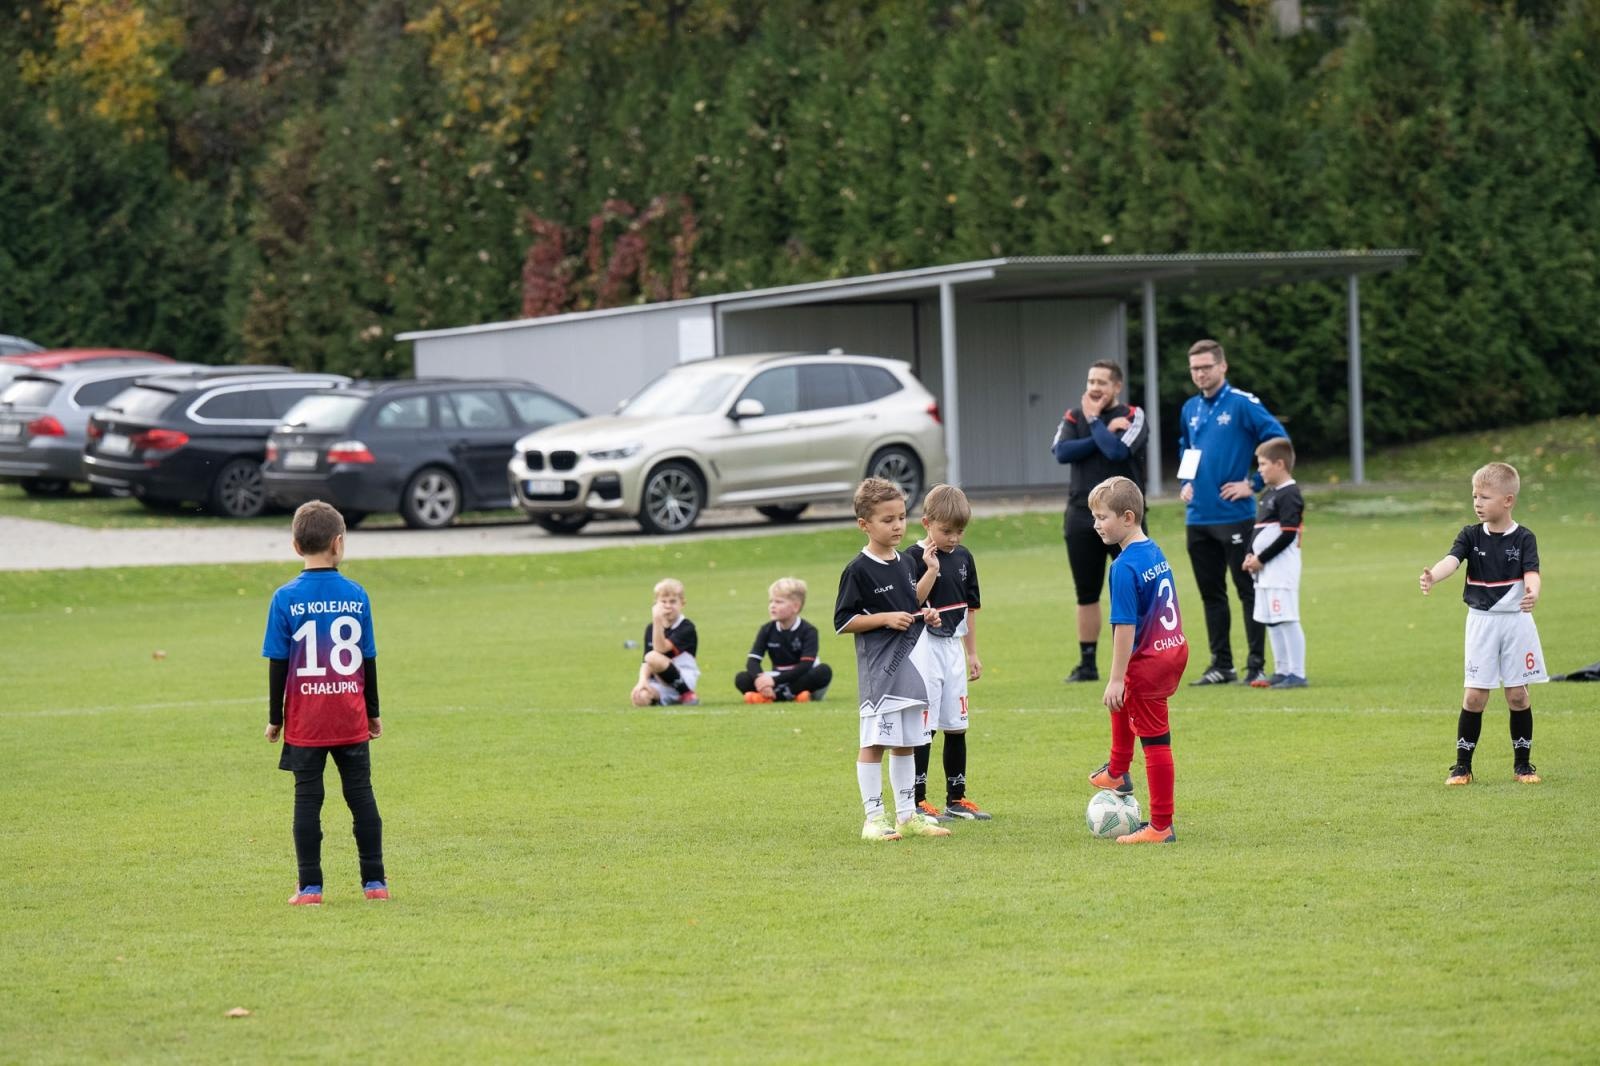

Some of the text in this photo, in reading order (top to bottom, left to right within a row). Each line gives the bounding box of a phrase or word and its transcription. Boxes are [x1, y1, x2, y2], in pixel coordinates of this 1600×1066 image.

[1142, 568, 1156, 583] KS
[290, 601, 363, 616] KS KOLEJARZ
[1158, 577, 1178, 631] 3
[1272, 600, 1281, 613] 6
[292, 615, 363, 677] 18
[1525, 652, 1535, 669] 6
[300, 682, 358, 694] CHAŁUPKI
